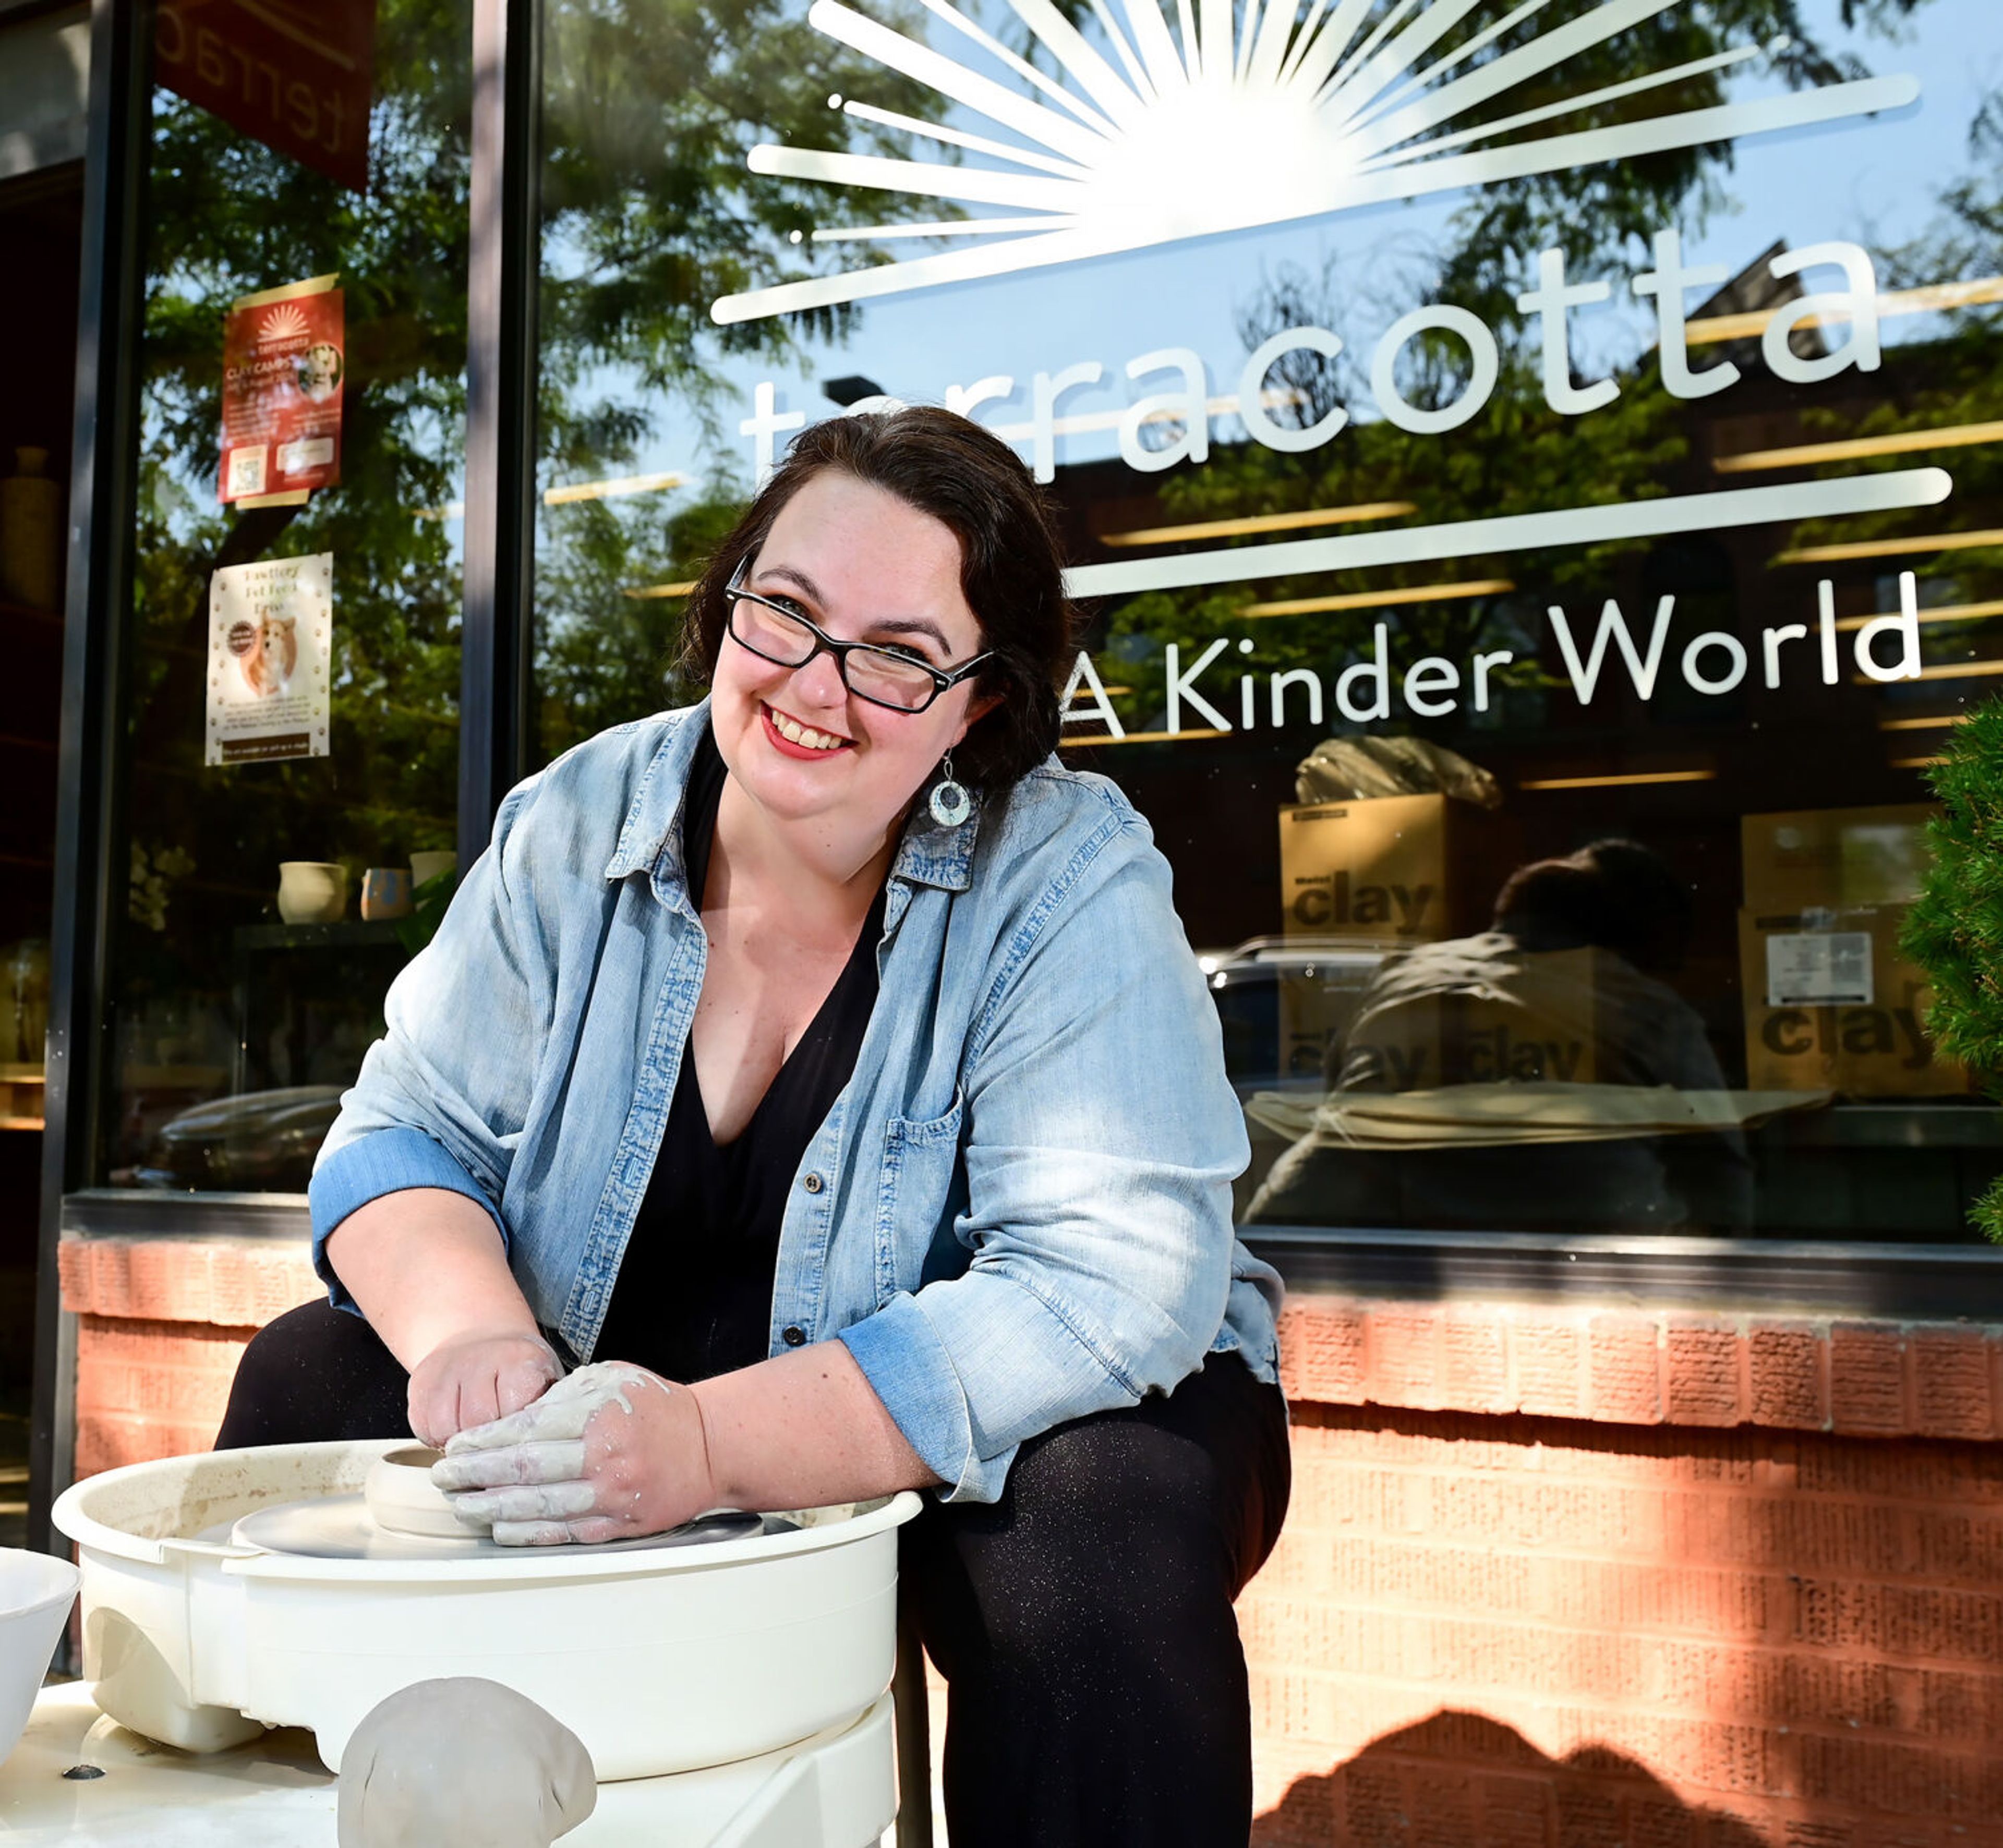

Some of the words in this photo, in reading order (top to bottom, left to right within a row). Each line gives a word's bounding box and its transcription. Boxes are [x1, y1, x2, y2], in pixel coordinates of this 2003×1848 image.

[1059, 650, 1126, 740] A
[1166, 622, 1514, 734] Kinder
[1548, 571, 1923, 706] World
[1294, 871, 1435, 935] clay
